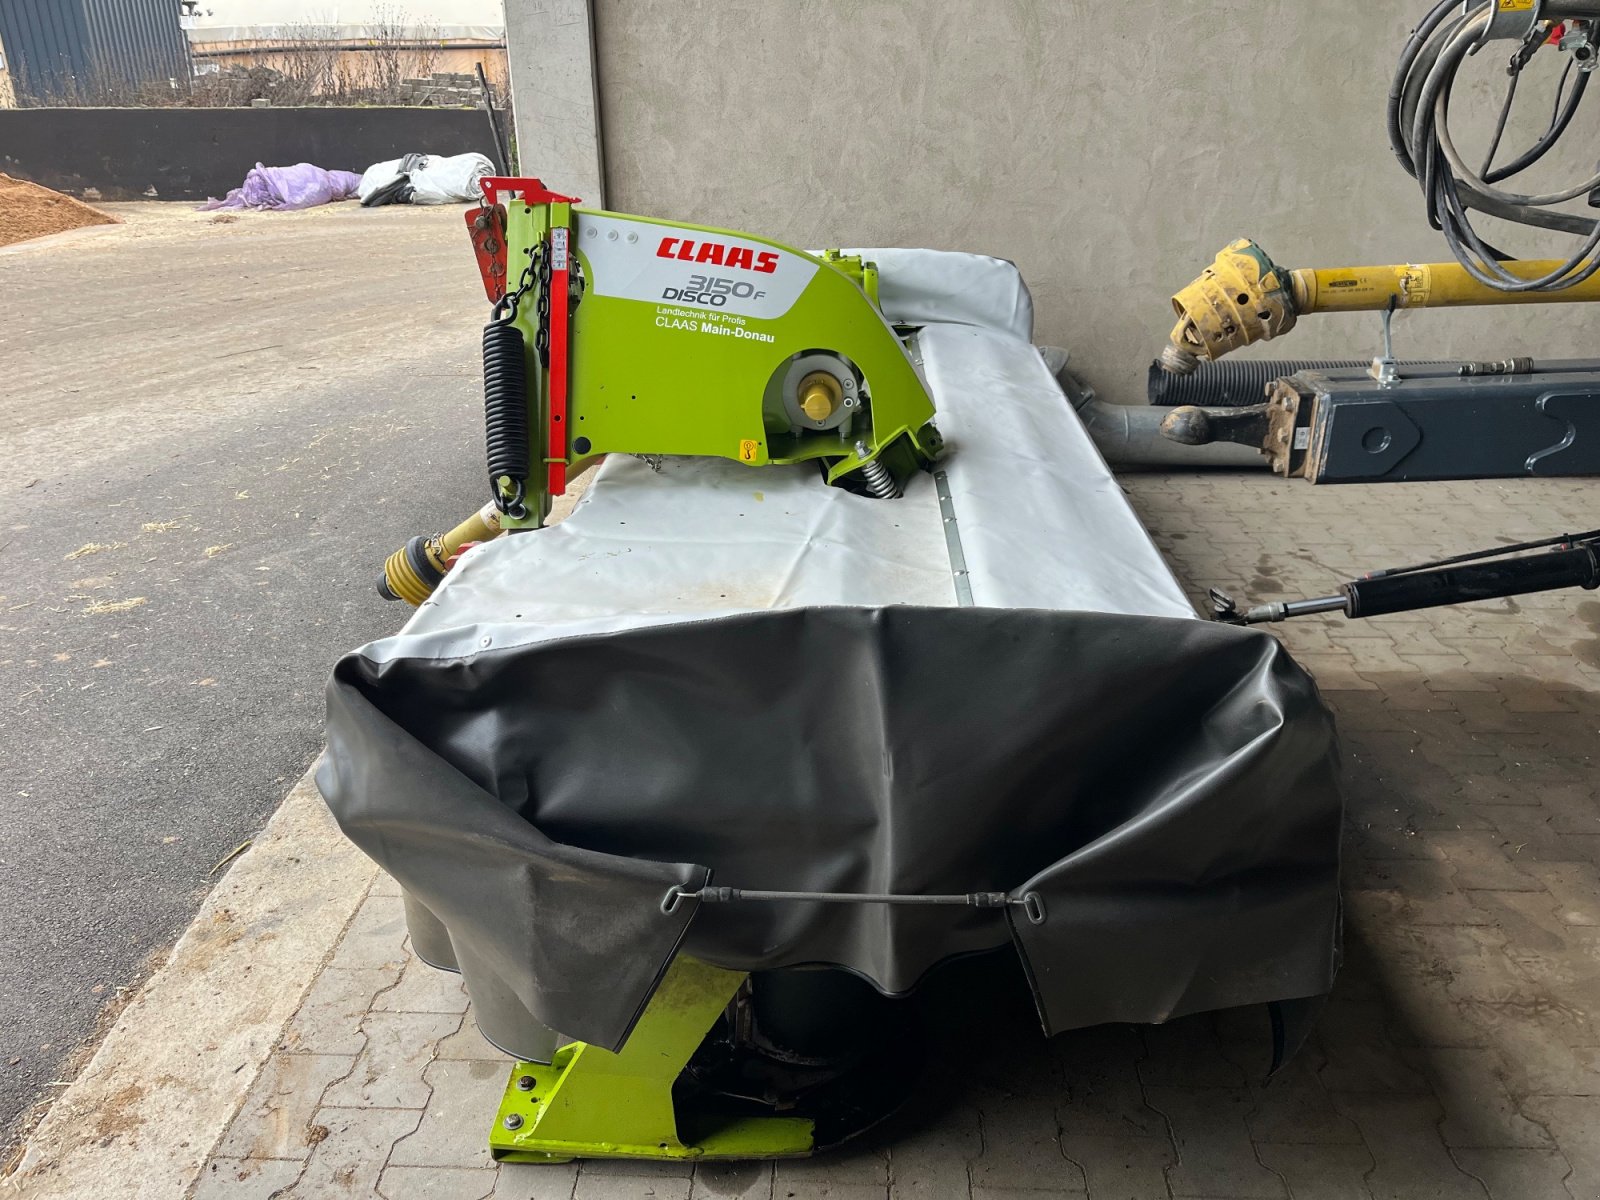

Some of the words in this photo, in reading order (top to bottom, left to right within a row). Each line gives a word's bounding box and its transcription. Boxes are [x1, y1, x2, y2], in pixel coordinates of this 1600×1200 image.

[656, 237, 779, 274] CLAAS
[662, 287, 727, 307] DISCO
[656, 305, 707, 320] Landtechnik
[708, 312, 720, 322] für
[721, 315, 746, 326] Profis
[655, 317, 698, 331] CLAAS
[701, 322, 775, 343] Main-Donau
